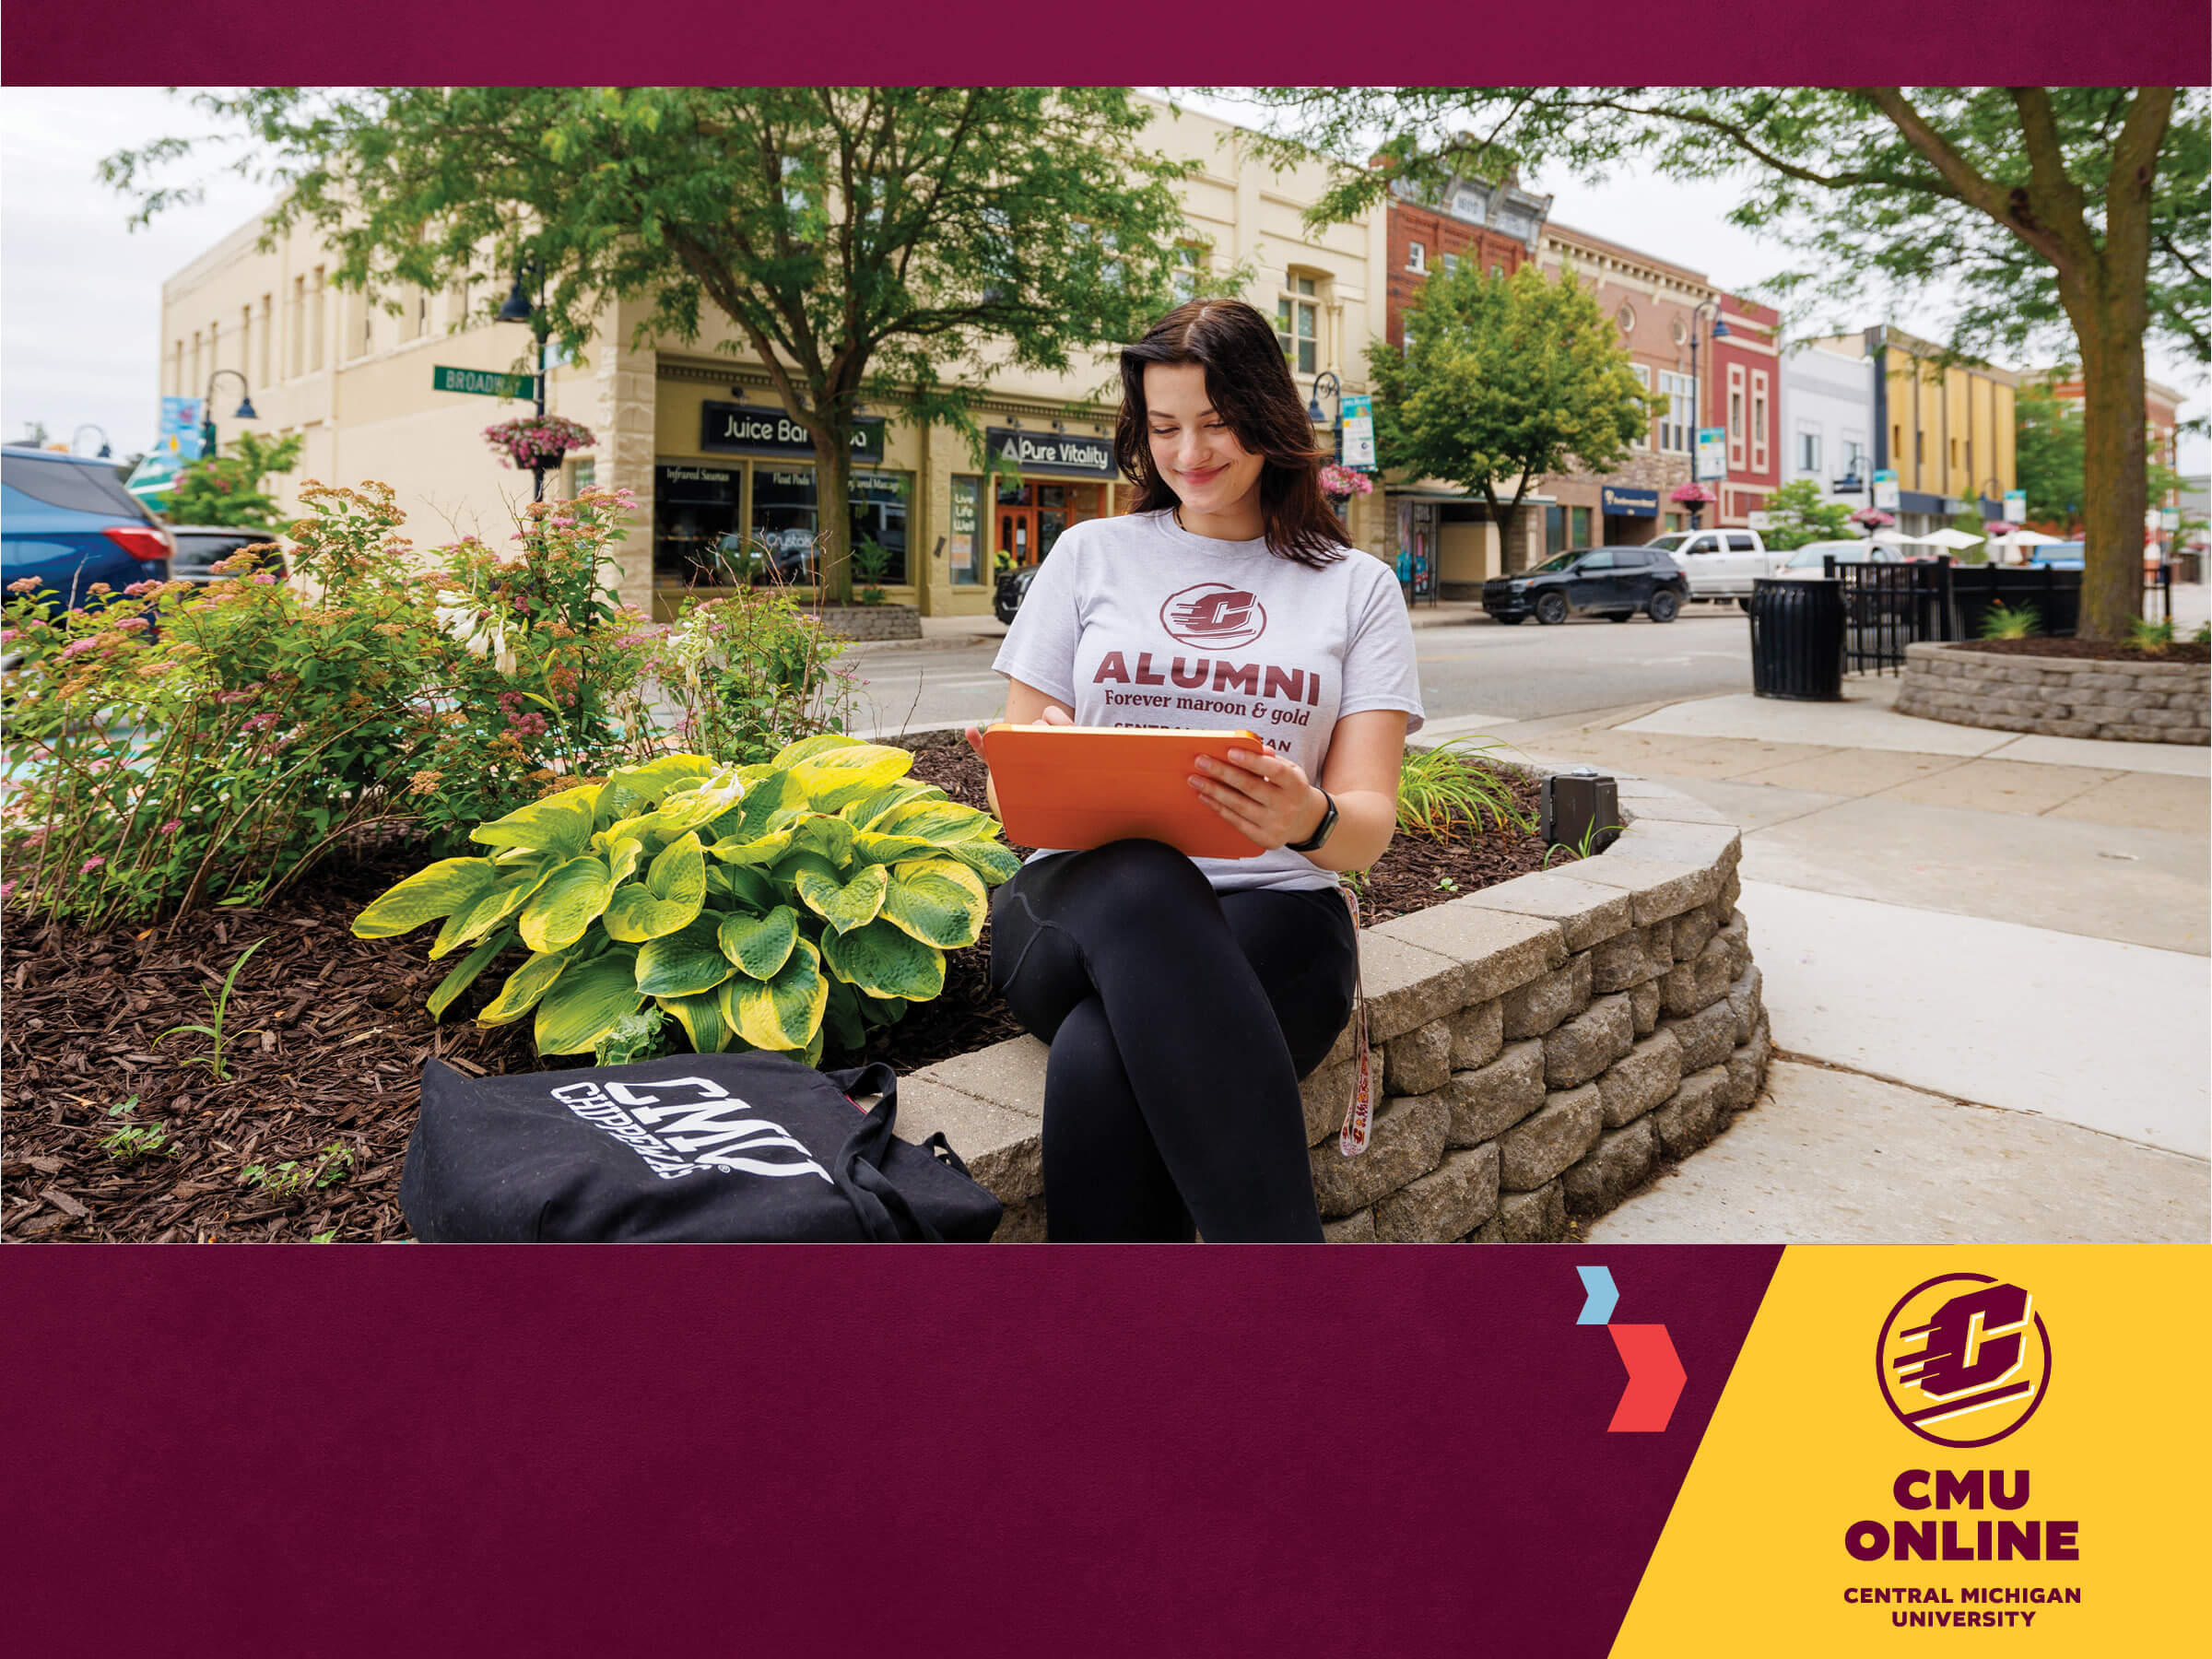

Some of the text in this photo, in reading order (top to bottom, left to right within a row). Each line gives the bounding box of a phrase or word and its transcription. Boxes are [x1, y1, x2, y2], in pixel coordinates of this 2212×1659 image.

[724, 414, 773, 441] Juice
[1021, 440, 1109, 471] Pure Vitality
[1093, 651, 1321, 707] ALUMNI
[1105, 688, 1311, 727] Forever maroon & gold
[550, 1082, 712, 1180] CHIPPEWAS
[604, 1077, 835, 1185] CMU
